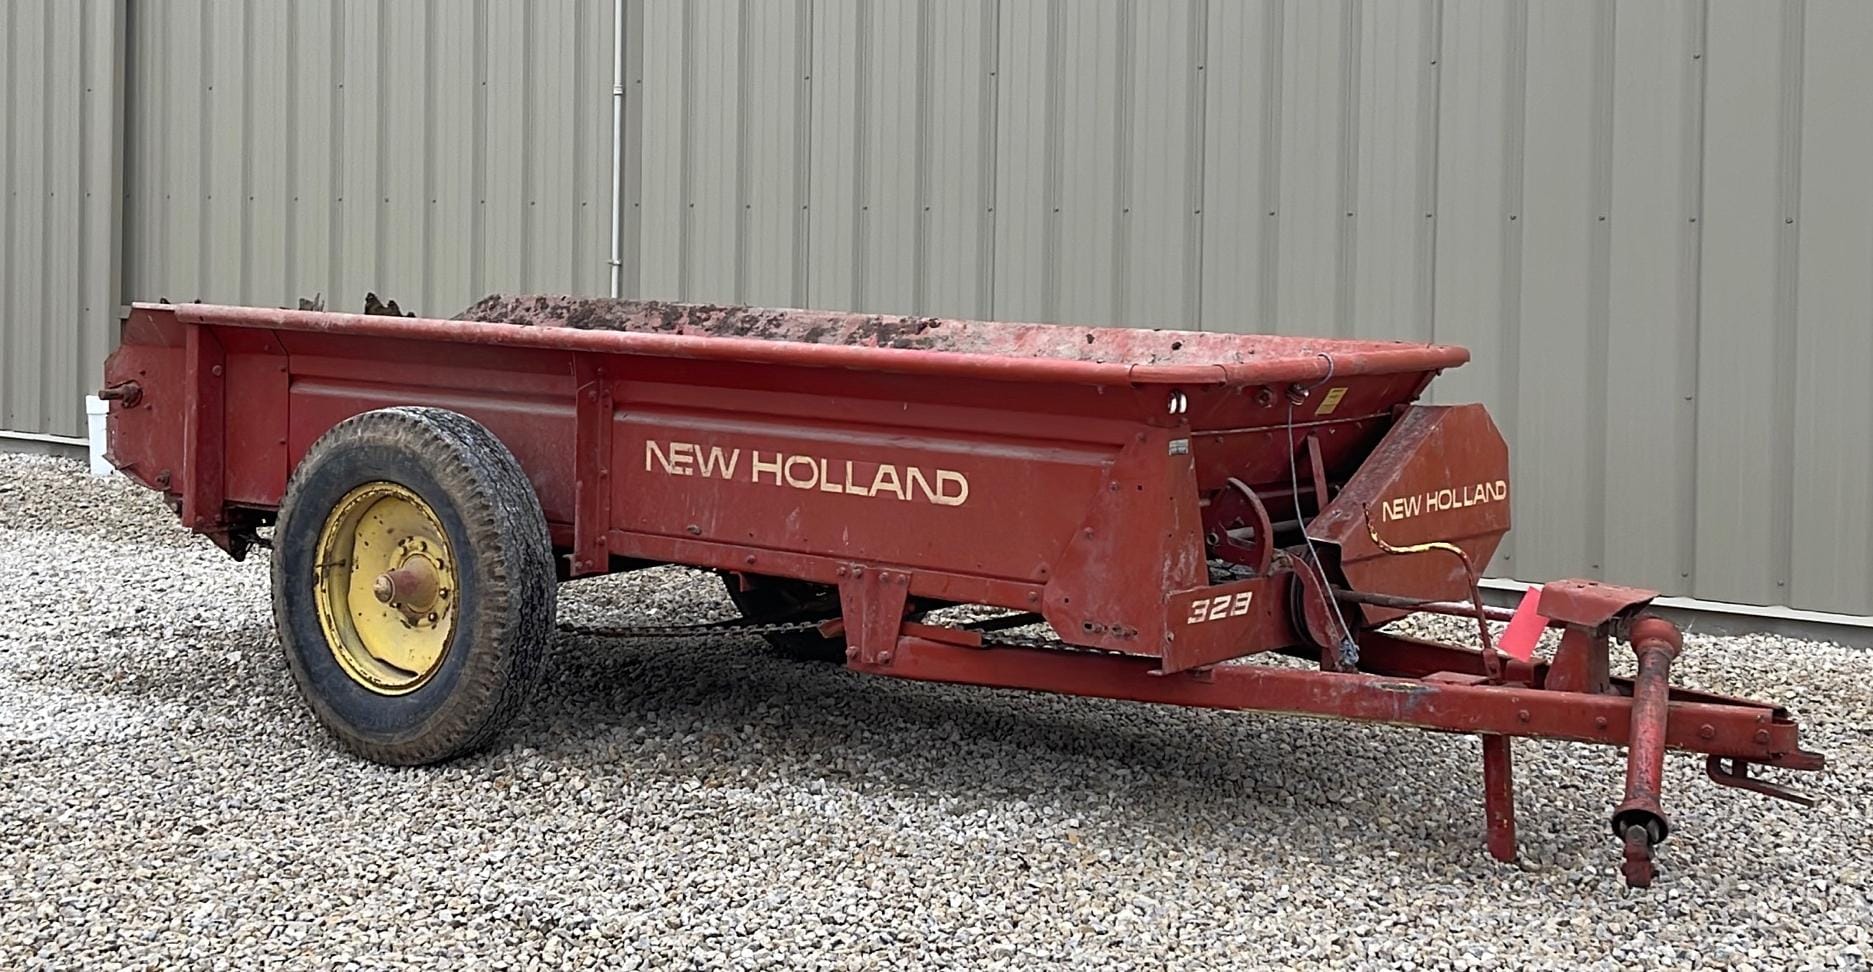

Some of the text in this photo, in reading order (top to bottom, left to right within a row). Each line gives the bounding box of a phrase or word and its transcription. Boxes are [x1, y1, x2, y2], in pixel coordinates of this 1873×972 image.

[646, 440, 969, 506] NEW HOLLAND
[1382, 480, 1507, 522] NEW HOLLAND
